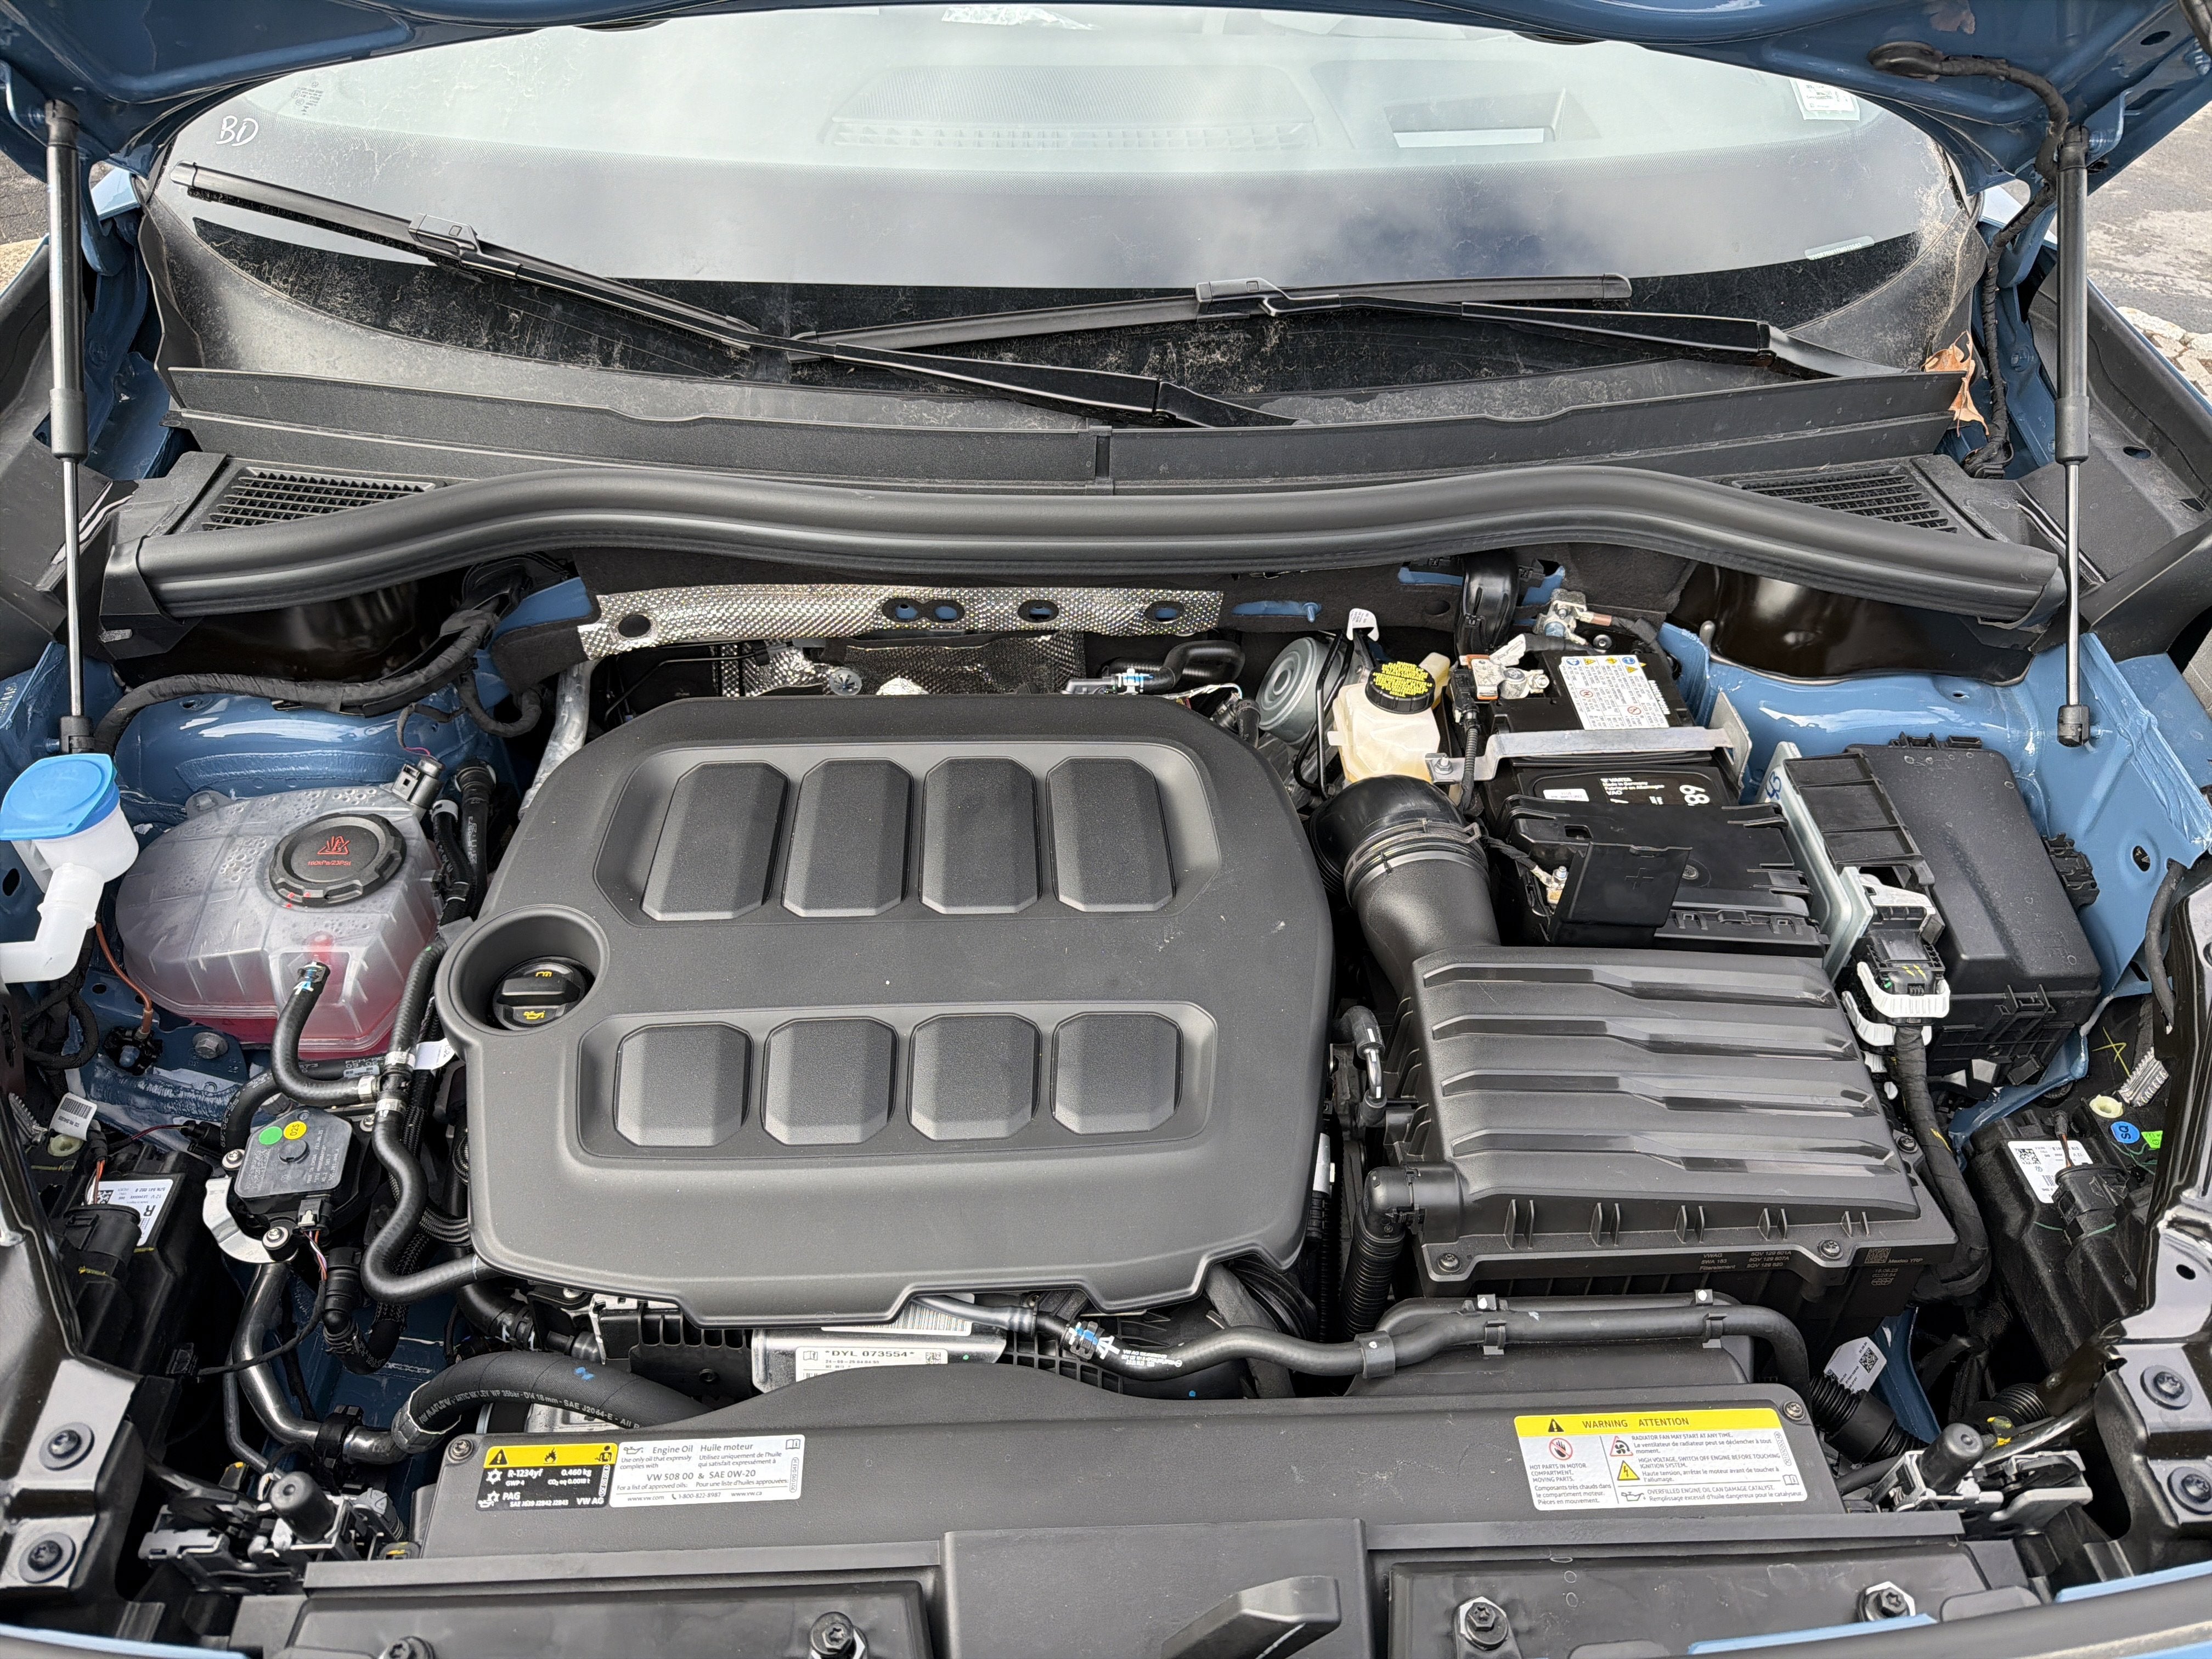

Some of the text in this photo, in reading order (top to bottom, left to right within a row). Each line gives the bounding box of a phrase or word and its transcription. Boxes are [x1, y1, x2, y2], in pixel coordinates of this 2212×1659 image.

[216, 115, 258, 146] BD
[143, 1205, 156, 1216] R
[563, 1399, 580, 1410] SAE
[1582, 1417, 1689, 1429] WARNING ATTENTION
[652, 1446, 680, 1455] Engine
[507, 1468, 543, 1479] R-1234yf
[583, 1469, 592, 1477] kg
[727, 1469, 756, 1477] 0W-20
[502, 1492, 521, 1500] PAG
[577, 1497, 591, 1505] VW
